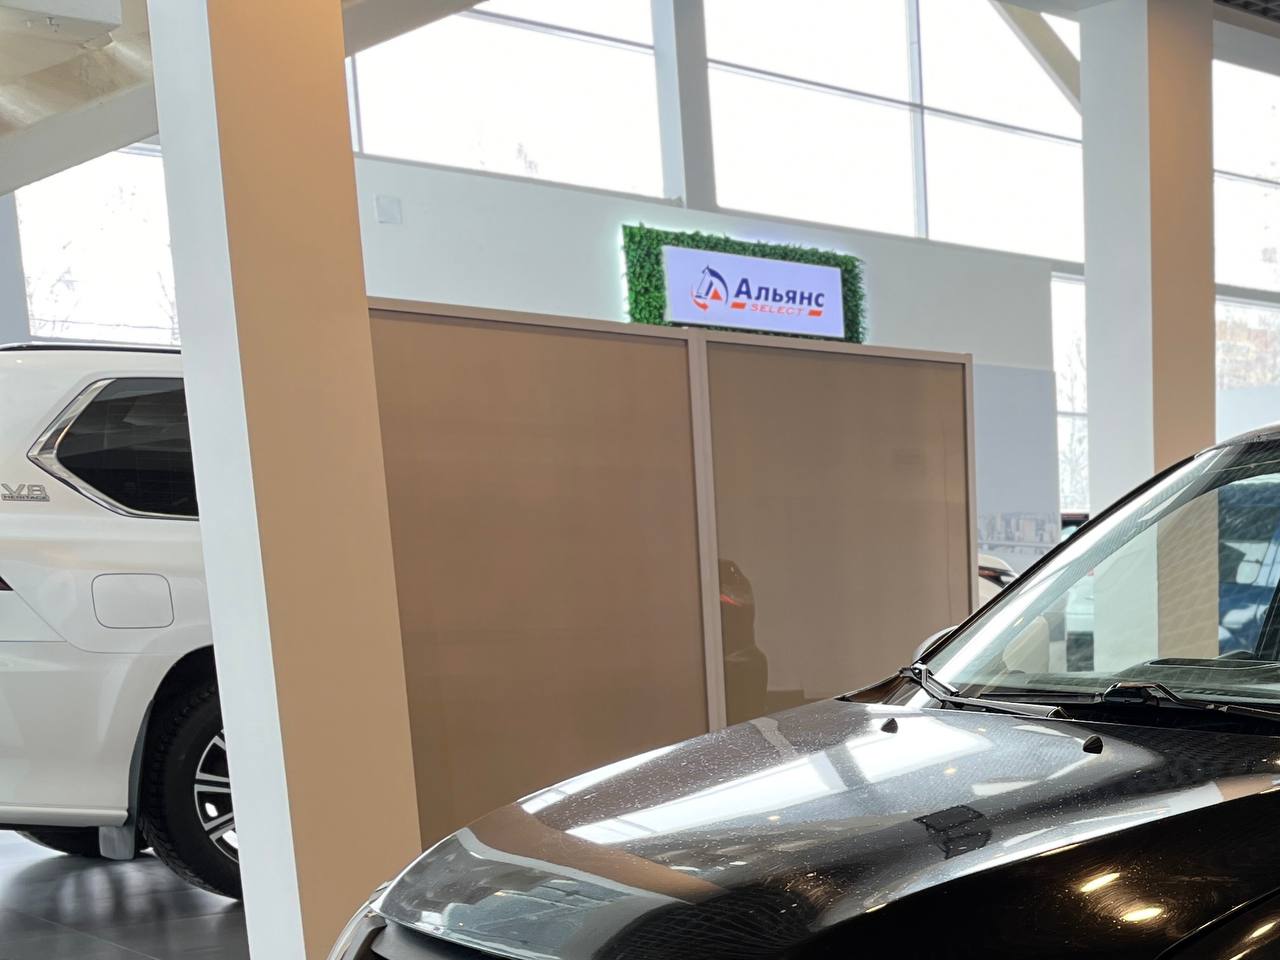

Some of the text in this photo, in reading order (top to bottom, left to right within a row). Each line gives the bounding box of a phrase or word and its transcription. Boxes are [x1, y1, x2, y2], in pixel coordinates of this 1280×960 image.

[734, 277, 825, 308] Альянс
[750, 304, 804, 316] SELECT
[1, 483, 47, 497] V8
